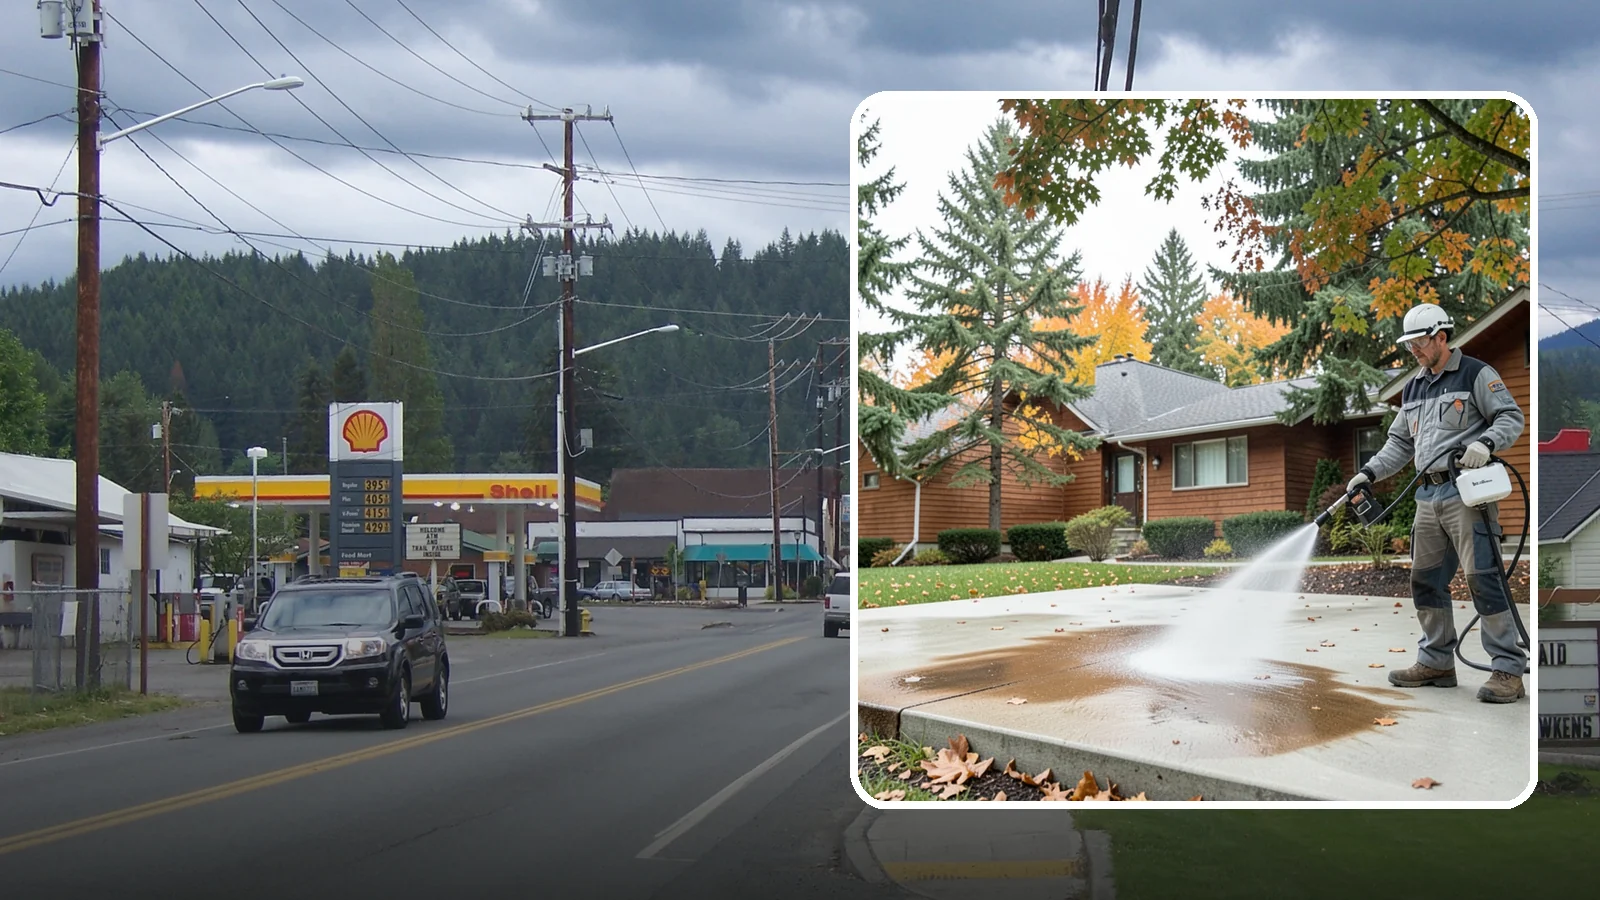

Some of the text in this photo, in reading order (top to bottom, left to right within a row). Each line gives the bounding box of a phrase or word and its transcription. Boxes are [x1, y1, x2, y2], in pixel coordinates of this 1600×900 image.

[366, 480, 383, 490] 395
[490, 484, 547, 499] Shell
[366, 494, 383, 504] 405
[366, 508, 383, 518] 415
[366, 522, 383, 532] 429
[1538, 643, 1567, 665] AID
